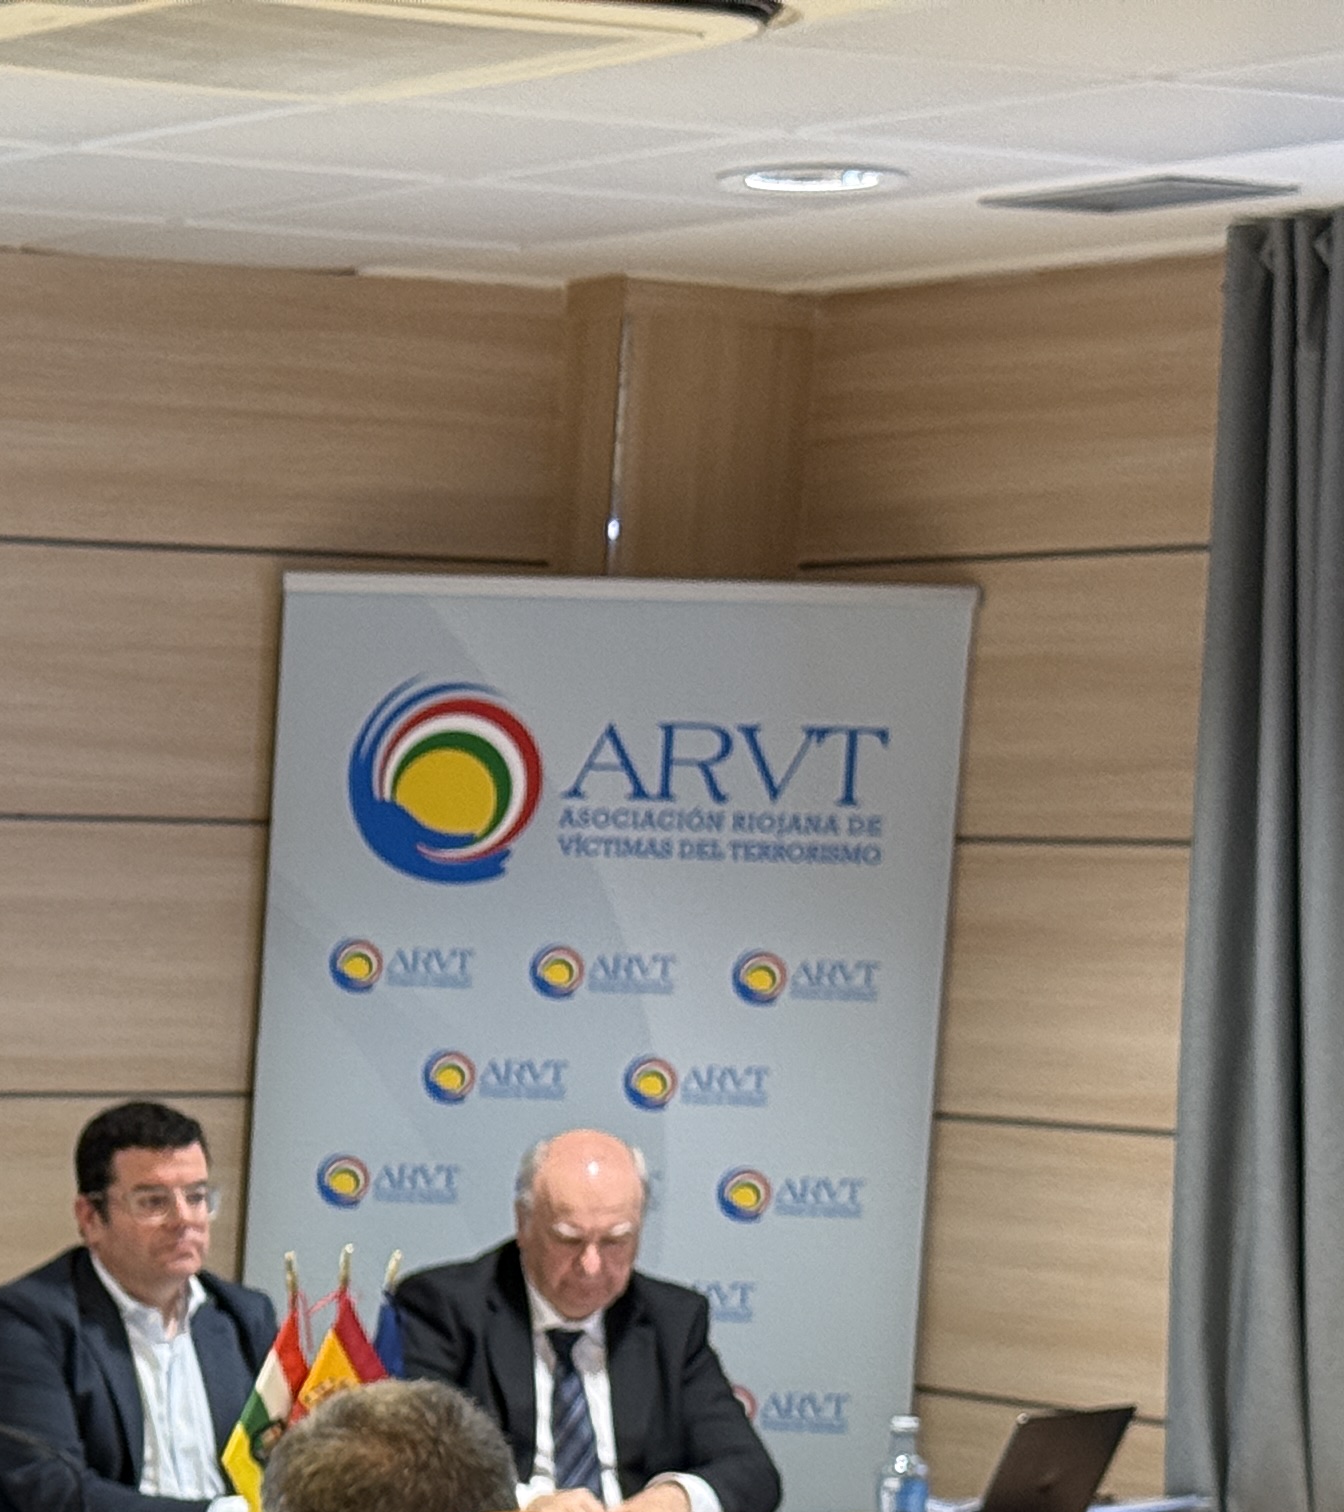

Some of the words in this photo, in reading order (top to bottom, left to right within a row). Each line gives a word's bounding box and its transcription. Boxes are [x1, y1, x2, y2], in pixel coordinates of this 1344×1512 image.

[562, 720, 890, 807] ARVT
[559, 806, 726, 833] ASOCIACIÓN
[731, 811, 841, 837] RIOJANA
[847, 813, 883, 837] DE
[558, 834, 675, 860] VÍCTIMAS
[677, 838, 725, 862] DEL
[728, 840, 883, 866] TERRORISMO
